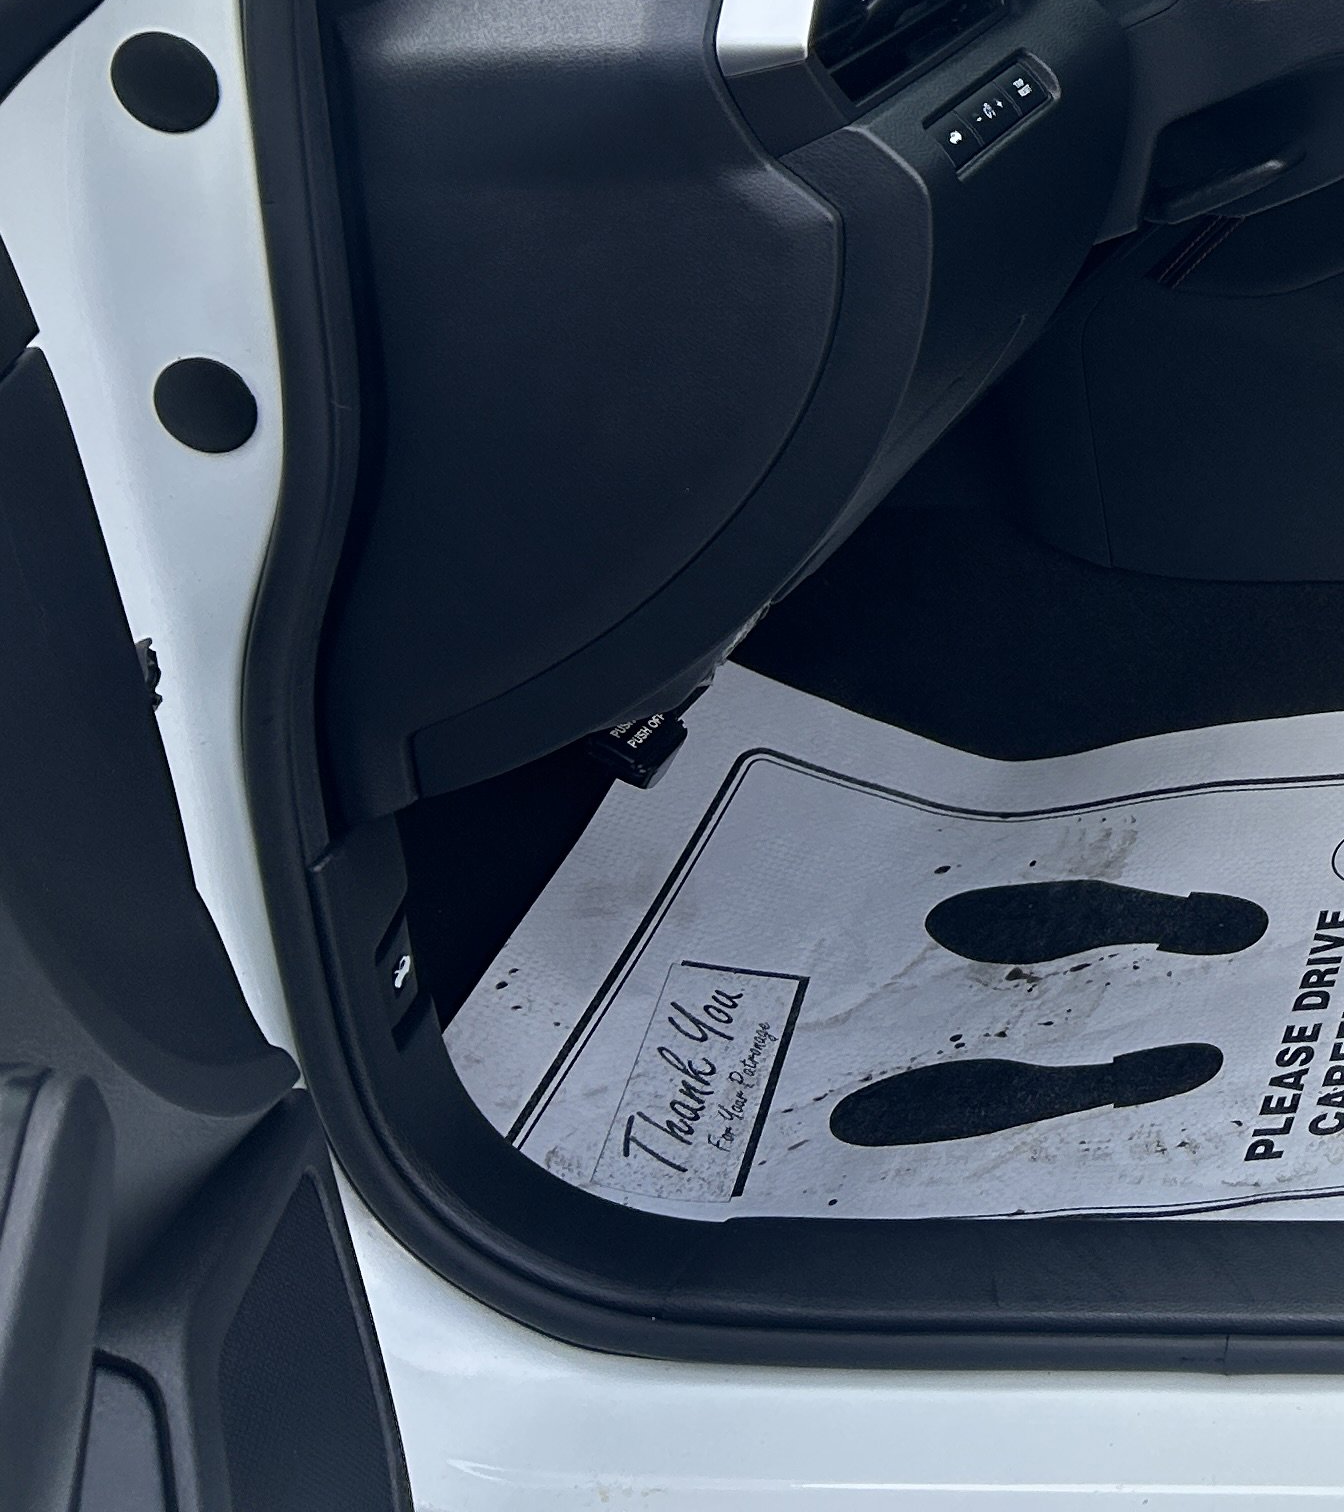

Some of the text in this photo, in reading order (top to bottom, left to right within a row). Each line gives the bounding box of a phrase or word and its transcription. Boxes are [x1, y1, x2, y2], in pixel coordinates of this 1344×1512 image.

[610, 719, 637, 738] PUS
[627, 726, 653, 748] PUSH
[623, 989, 744, 1173] Thank You
[707, 1126, 734, 1152] For
[729, 1021, 778, 1089] Patronage
[1244, 1022, 1323, 1162] PLEASE
